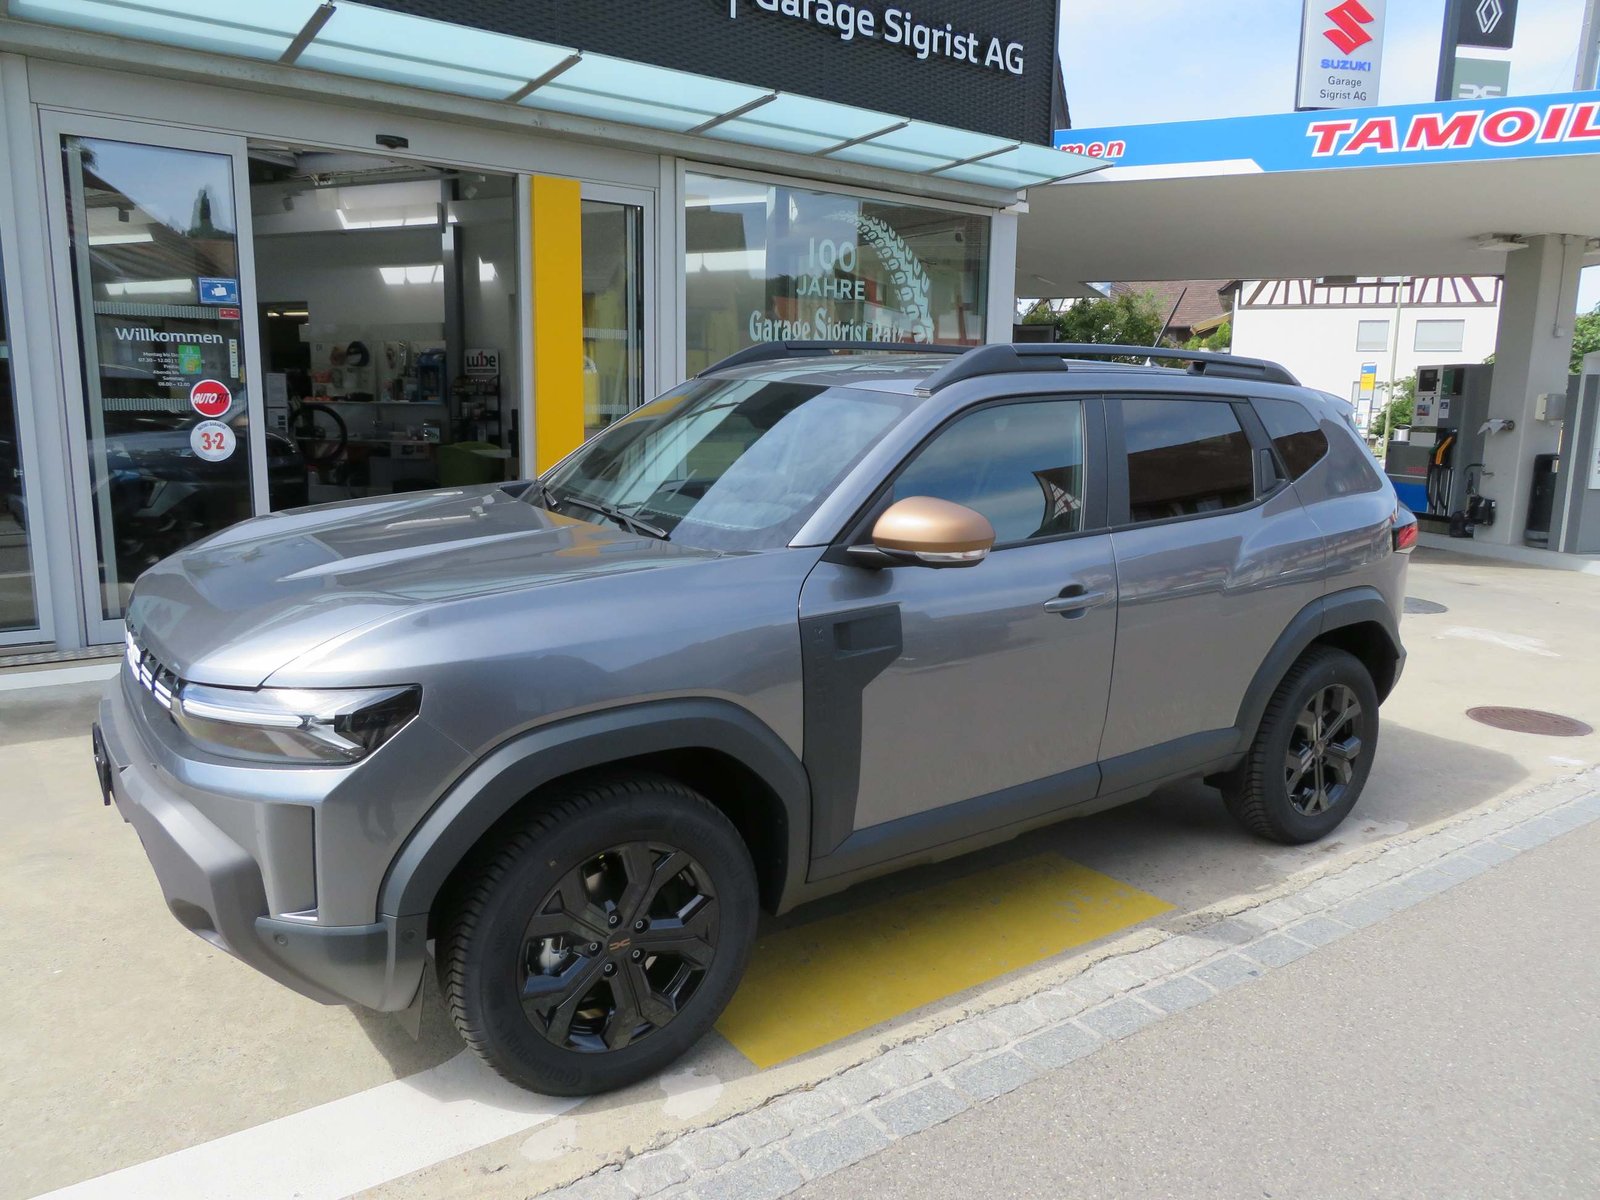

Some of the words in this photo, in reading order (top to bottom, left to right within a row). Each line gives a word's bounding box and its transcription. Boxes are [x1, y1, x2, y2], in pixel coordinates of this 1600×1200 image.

[884, 8, 978, 63] Sigrist
[985, 38, 1024, 75] AG
[1320, 58, 1371, 72] SUZUKI
[1327, 75, 1362, 87] Garage
[1319, 89, 1351, 101] Sigrist
[1353, 91, 1367, 101] AG
[1306, 102, 1600, 157] TAMOIL
[796, 278, 866, 300] JAHRE
[750, 310, 811, 342] Garage
[814, 308, 869, 341] Sigrist
[115, 327, 224, 344] Willkommen
[201, 432, 225, 451] 3+2
